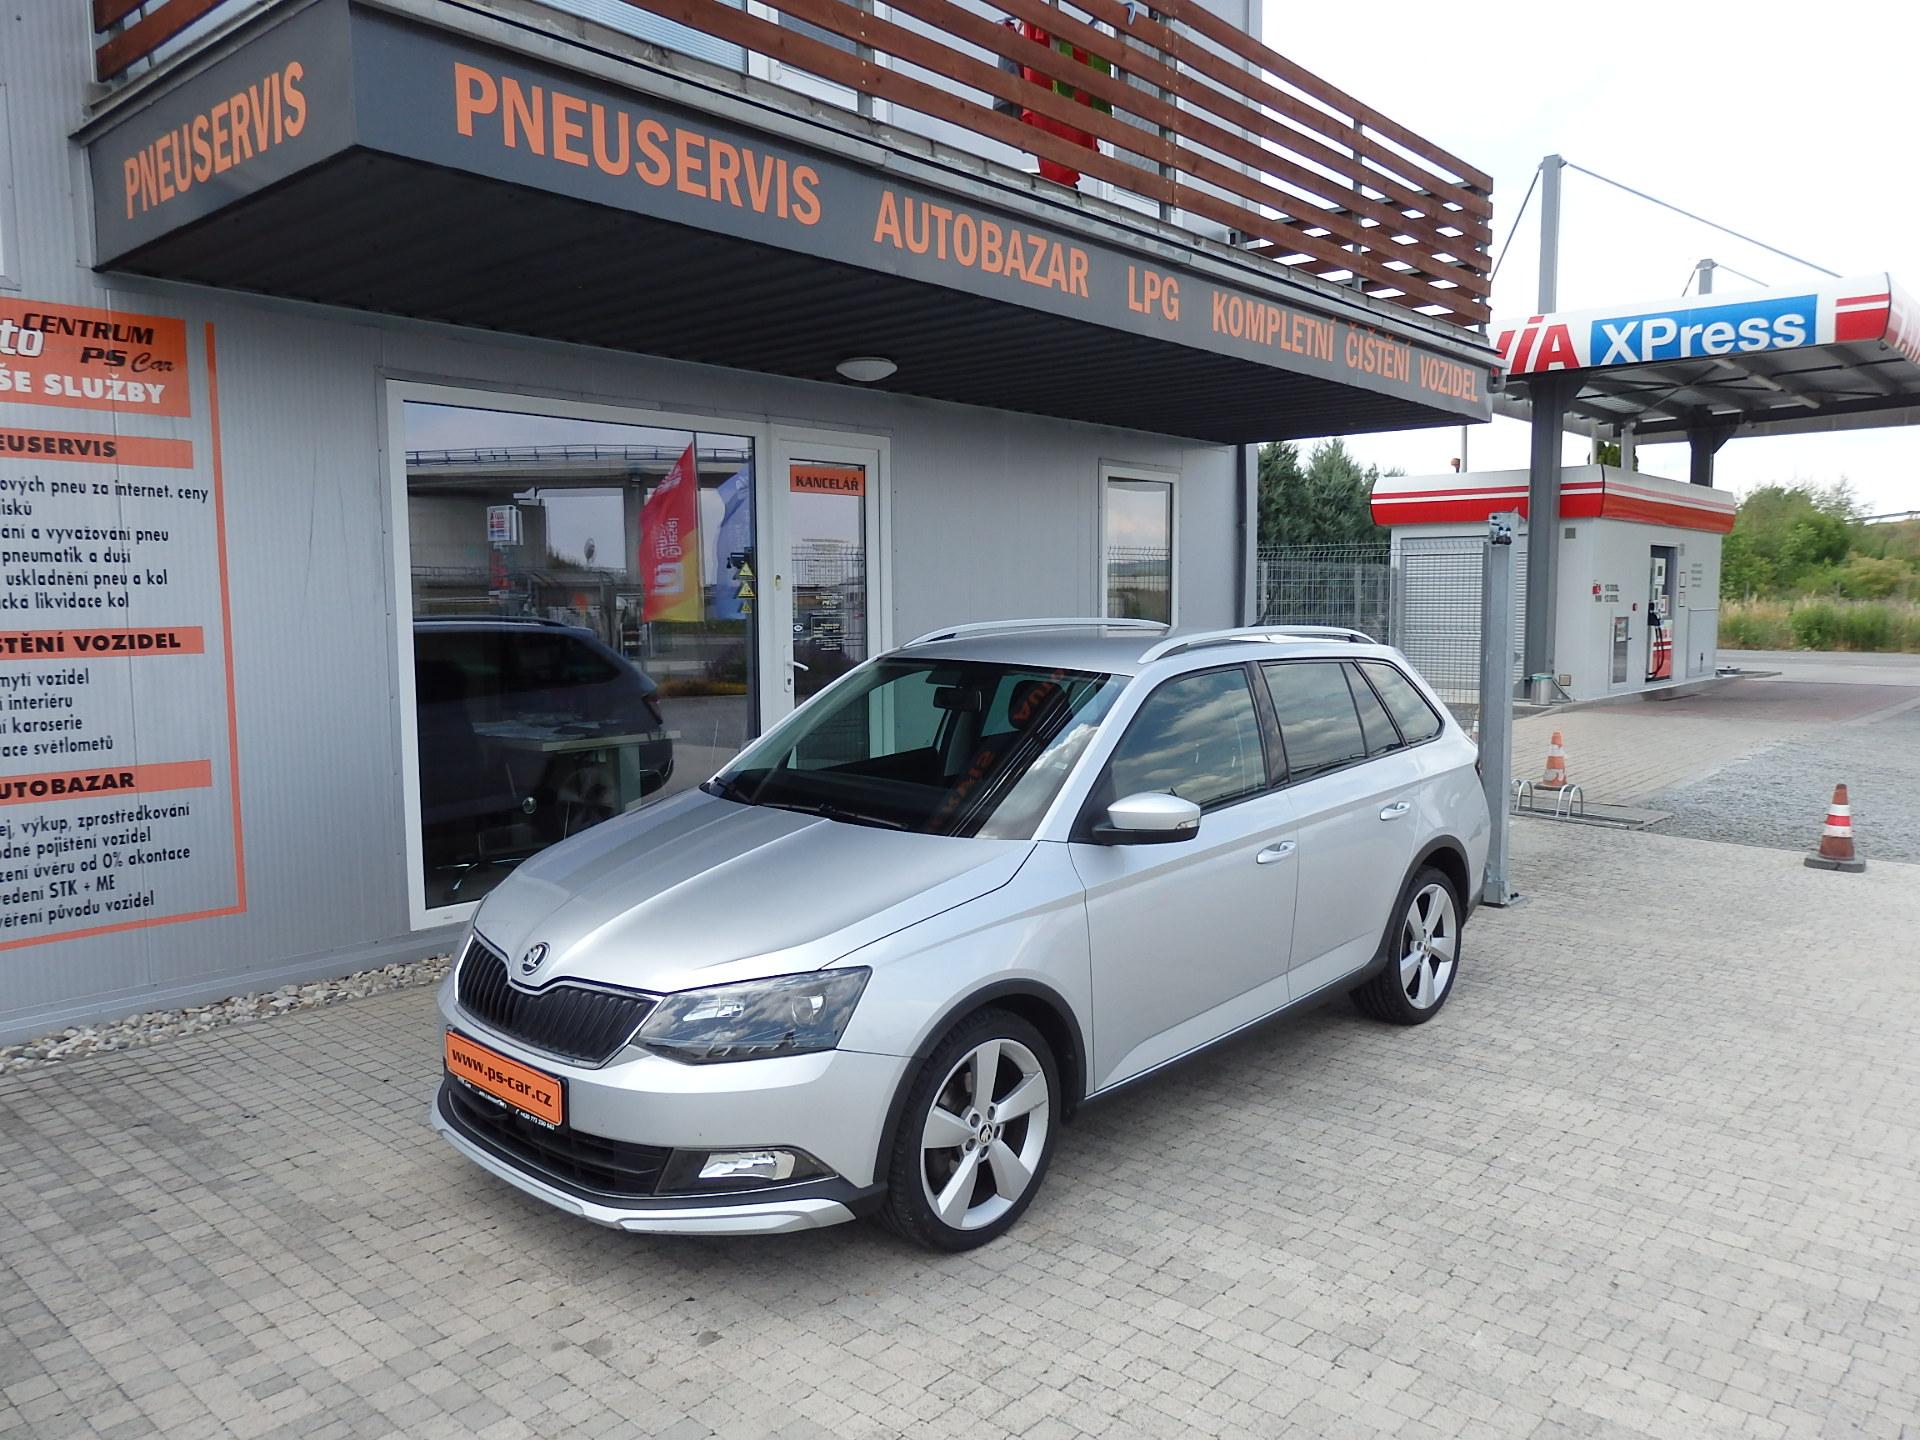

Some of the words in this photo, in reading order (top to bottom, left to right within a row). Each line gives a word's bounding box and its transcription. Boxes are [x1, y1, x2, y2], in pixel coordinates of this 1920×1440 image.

[124, 61, 307, 219] PNEUSERVIS
[454, 62, 821, 225] PNEUSERVIS
[873, 190, 1089, 298] AUTOBAZAR
[1128, 265, 1179, 321] LPG
[1212, 290, 1335, 362] KOMPLETNÍ
[1345, 322, 1411, 383] ČIŠTĚNÍ
[1420, 354, 1478, 402] VOZIDEL
[23, 313, 154, 345] CENTRUM
[1600, 312, 1805, 365] XPress
[80, 347, 128, 367] PS
[131, 352, 175, 373] Car
[44, 373, 165, 404] SLUŽBY
[51, 480, 87, 496] pneu
[92, 483, 109, 495] za
[178, 486, 208, 503] ceny
[795, 475, 859, 491] KANCELÁŘ
[0, 498, 32, 515] isků
[31, 528, 40, 539] a
[46, 525, 131, 544] vyvažování
[136, 529, 169, 544] pneu
[2, 546, 83, 566] pneumatik
[89, 552, 98, 563] a
[104, 547, 131, 563] duší
[6, 568, 88, 586] uskladnění
[94, 573, 128, 589] pneu
[133, 574, 141, 585] a
[147, 569, 168, 585] kol
[0, 592, 29, 609] cká
[35, 592, 102, 609] likvidace
[108, 592, 129, 608] kol
[73, 633, 181, 651] VOZIDEL
[37, 668, 89, 686] vozidel
[9, 692, 73, 711] interiéru
[12, 714, 83, 733] karoserie
[0, 745, 28, 757] ace
[34, 735, 113, 755] světlometů
[21, 816, 72, 837] výkup,
[78, 803, 190, 830] zprostředkování
[0, 842, 31, 859] dné
[37, 836, 97, 859] pojištění
[102, 826, 151, 846] vozidel
[34, 862, 75, 878] úvěru
[81, 856, 97, 872] od
[103, 851, 123, 869] 0%
[128, 847, 191, 866] akontace
[0, 885, 44, 905] edení
[50, 880, 78, 899] STK
[96, 874, 115, 892] ME
[48, 901, 100, 925] původu
[105, 890, 154, 912] vozidel
[452, 1049, 552, 1108] www.ps-car.cz
